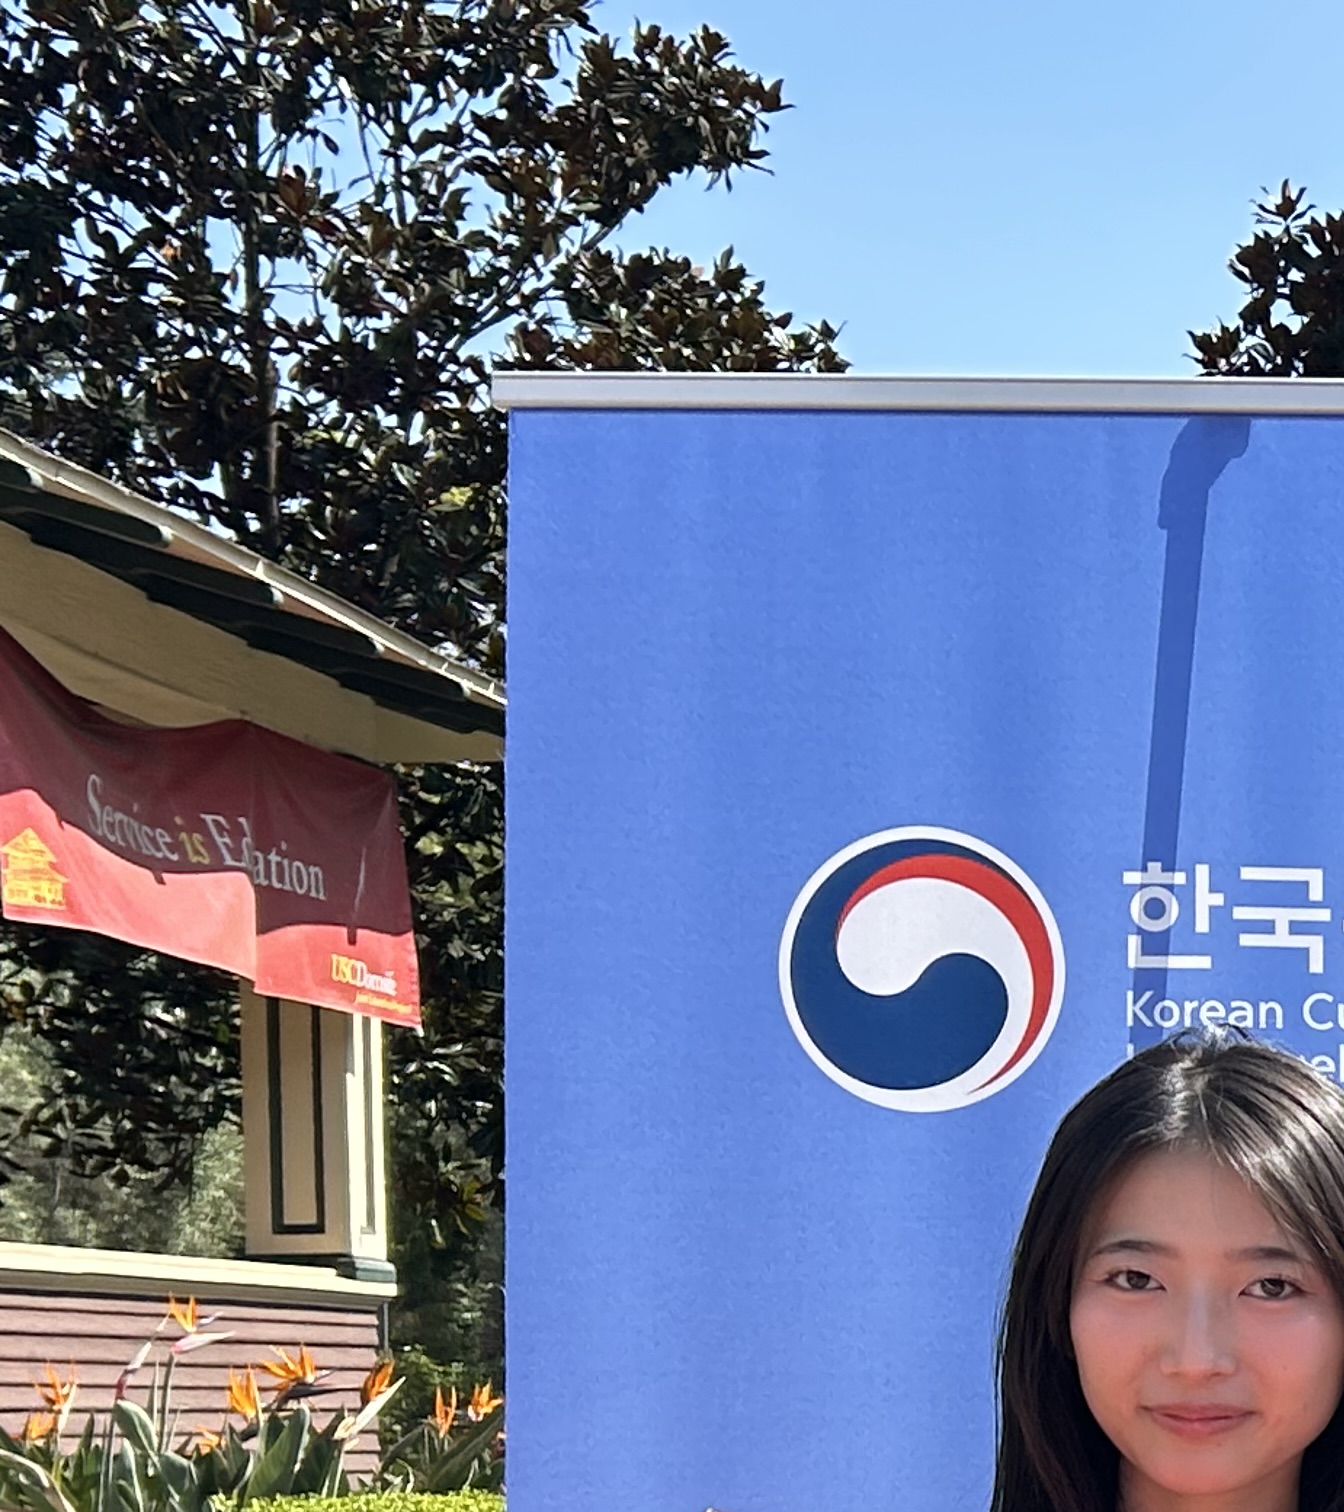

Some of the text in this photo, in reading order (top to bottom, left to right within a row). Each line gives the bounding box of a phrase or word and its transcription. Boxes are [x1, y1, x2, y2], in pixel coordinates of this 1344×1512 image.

[87, 774, 327, 901] Service is Edation
[1125, 989, 1284, 1031] Korean
